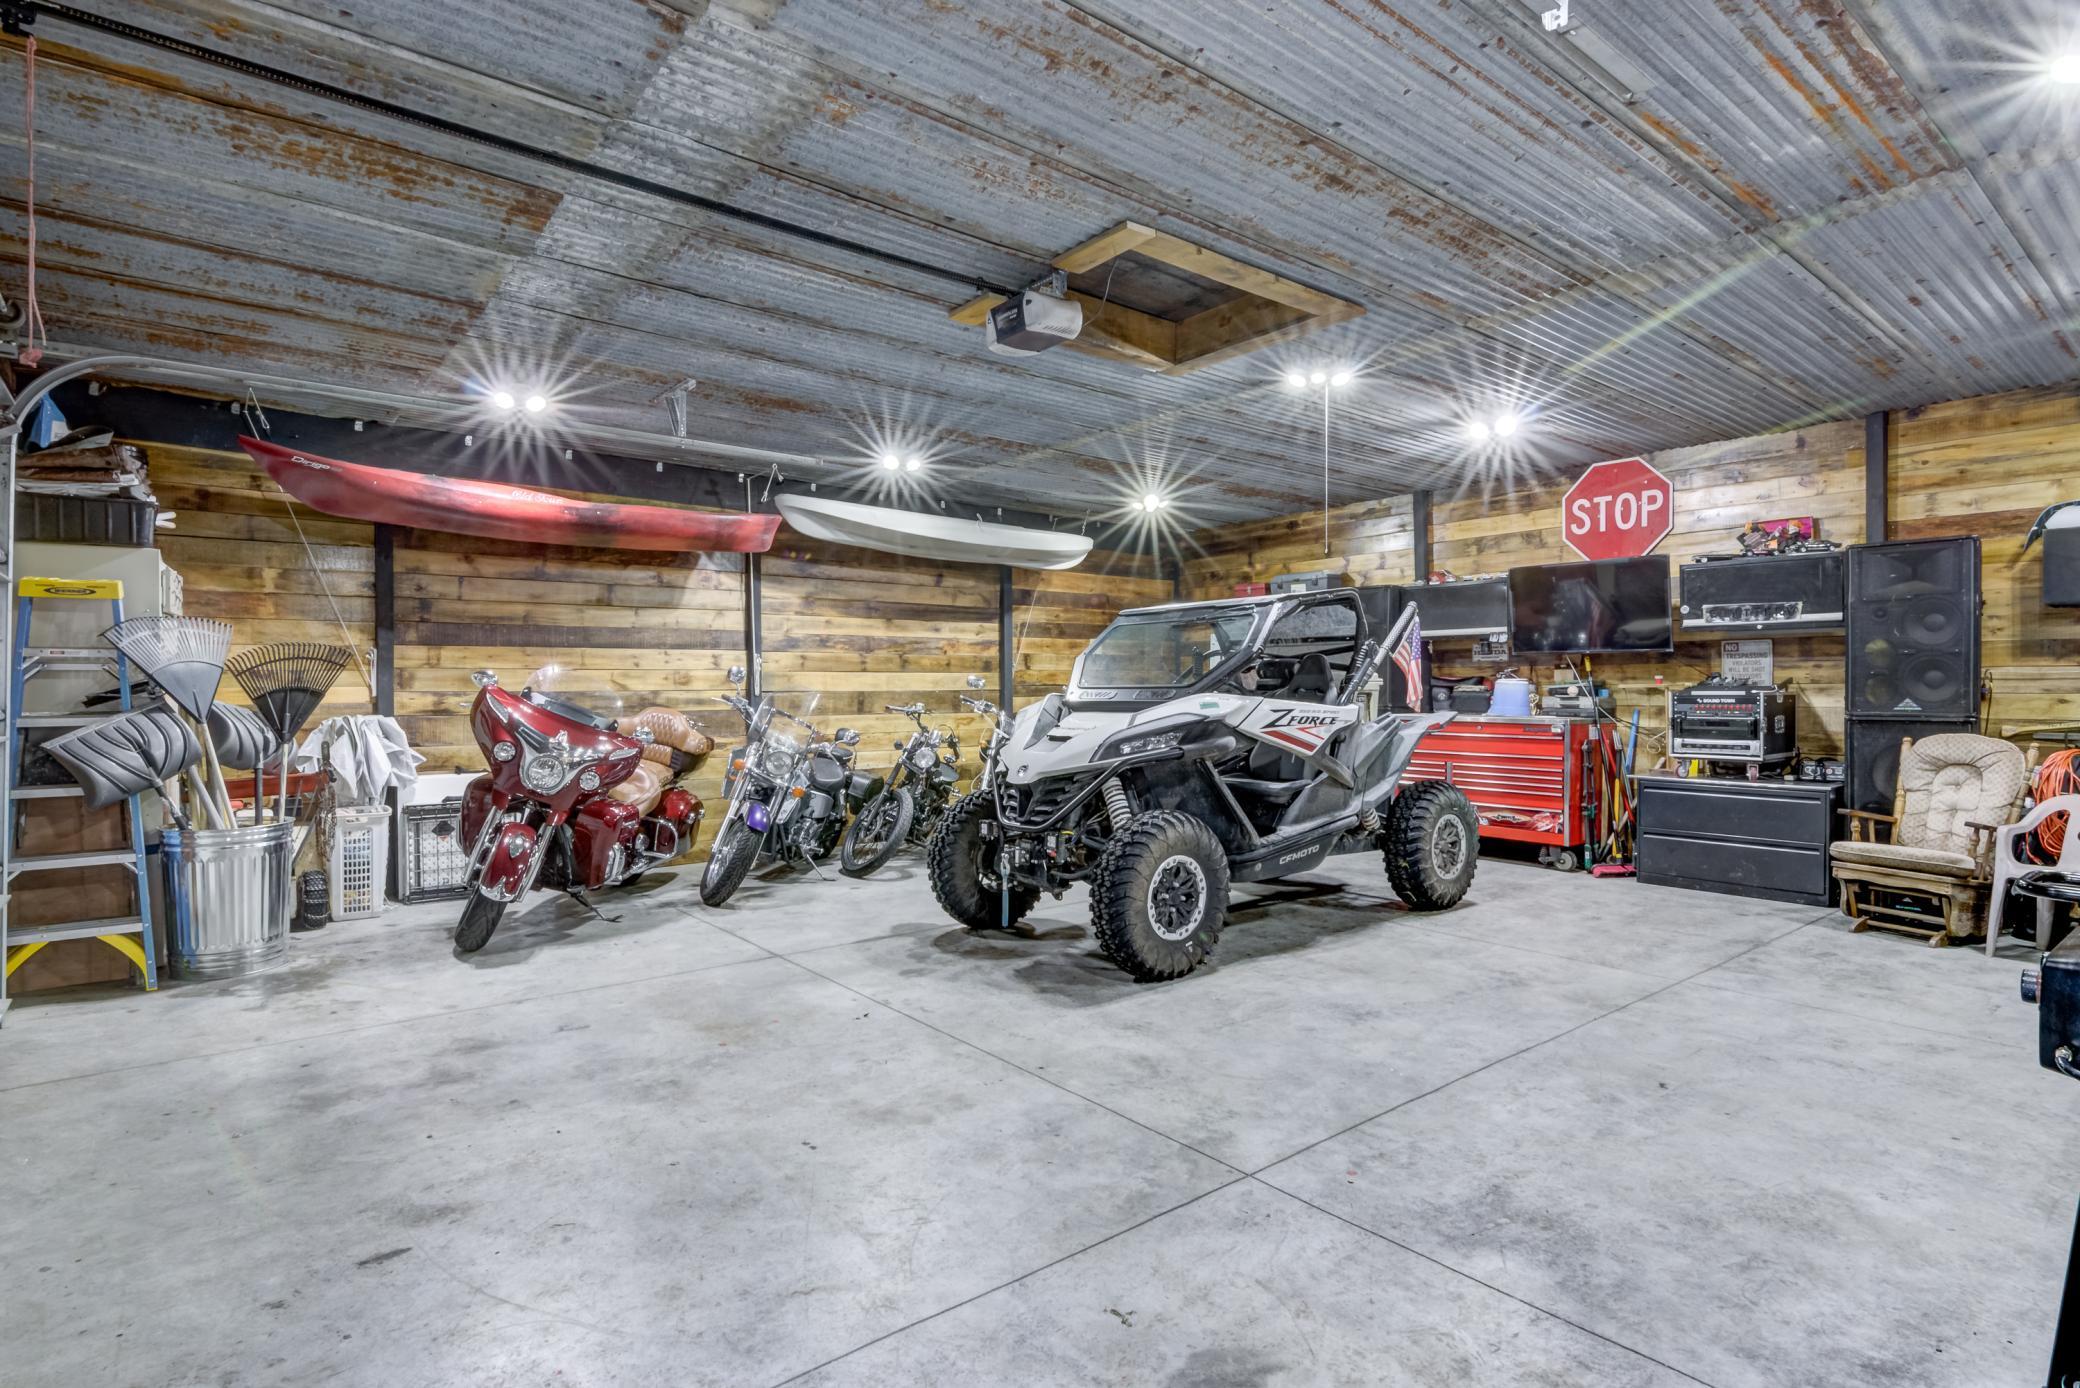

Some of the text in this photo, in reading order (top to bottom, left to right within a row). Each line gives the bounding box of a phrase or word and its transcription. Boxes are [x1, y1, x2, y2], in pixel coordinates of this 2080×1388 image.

[1570, 488, 1664, 535] STOP
[1725, 643, 1738, 651] NO
[1279, 844, 1320, 865] CFMOTO
